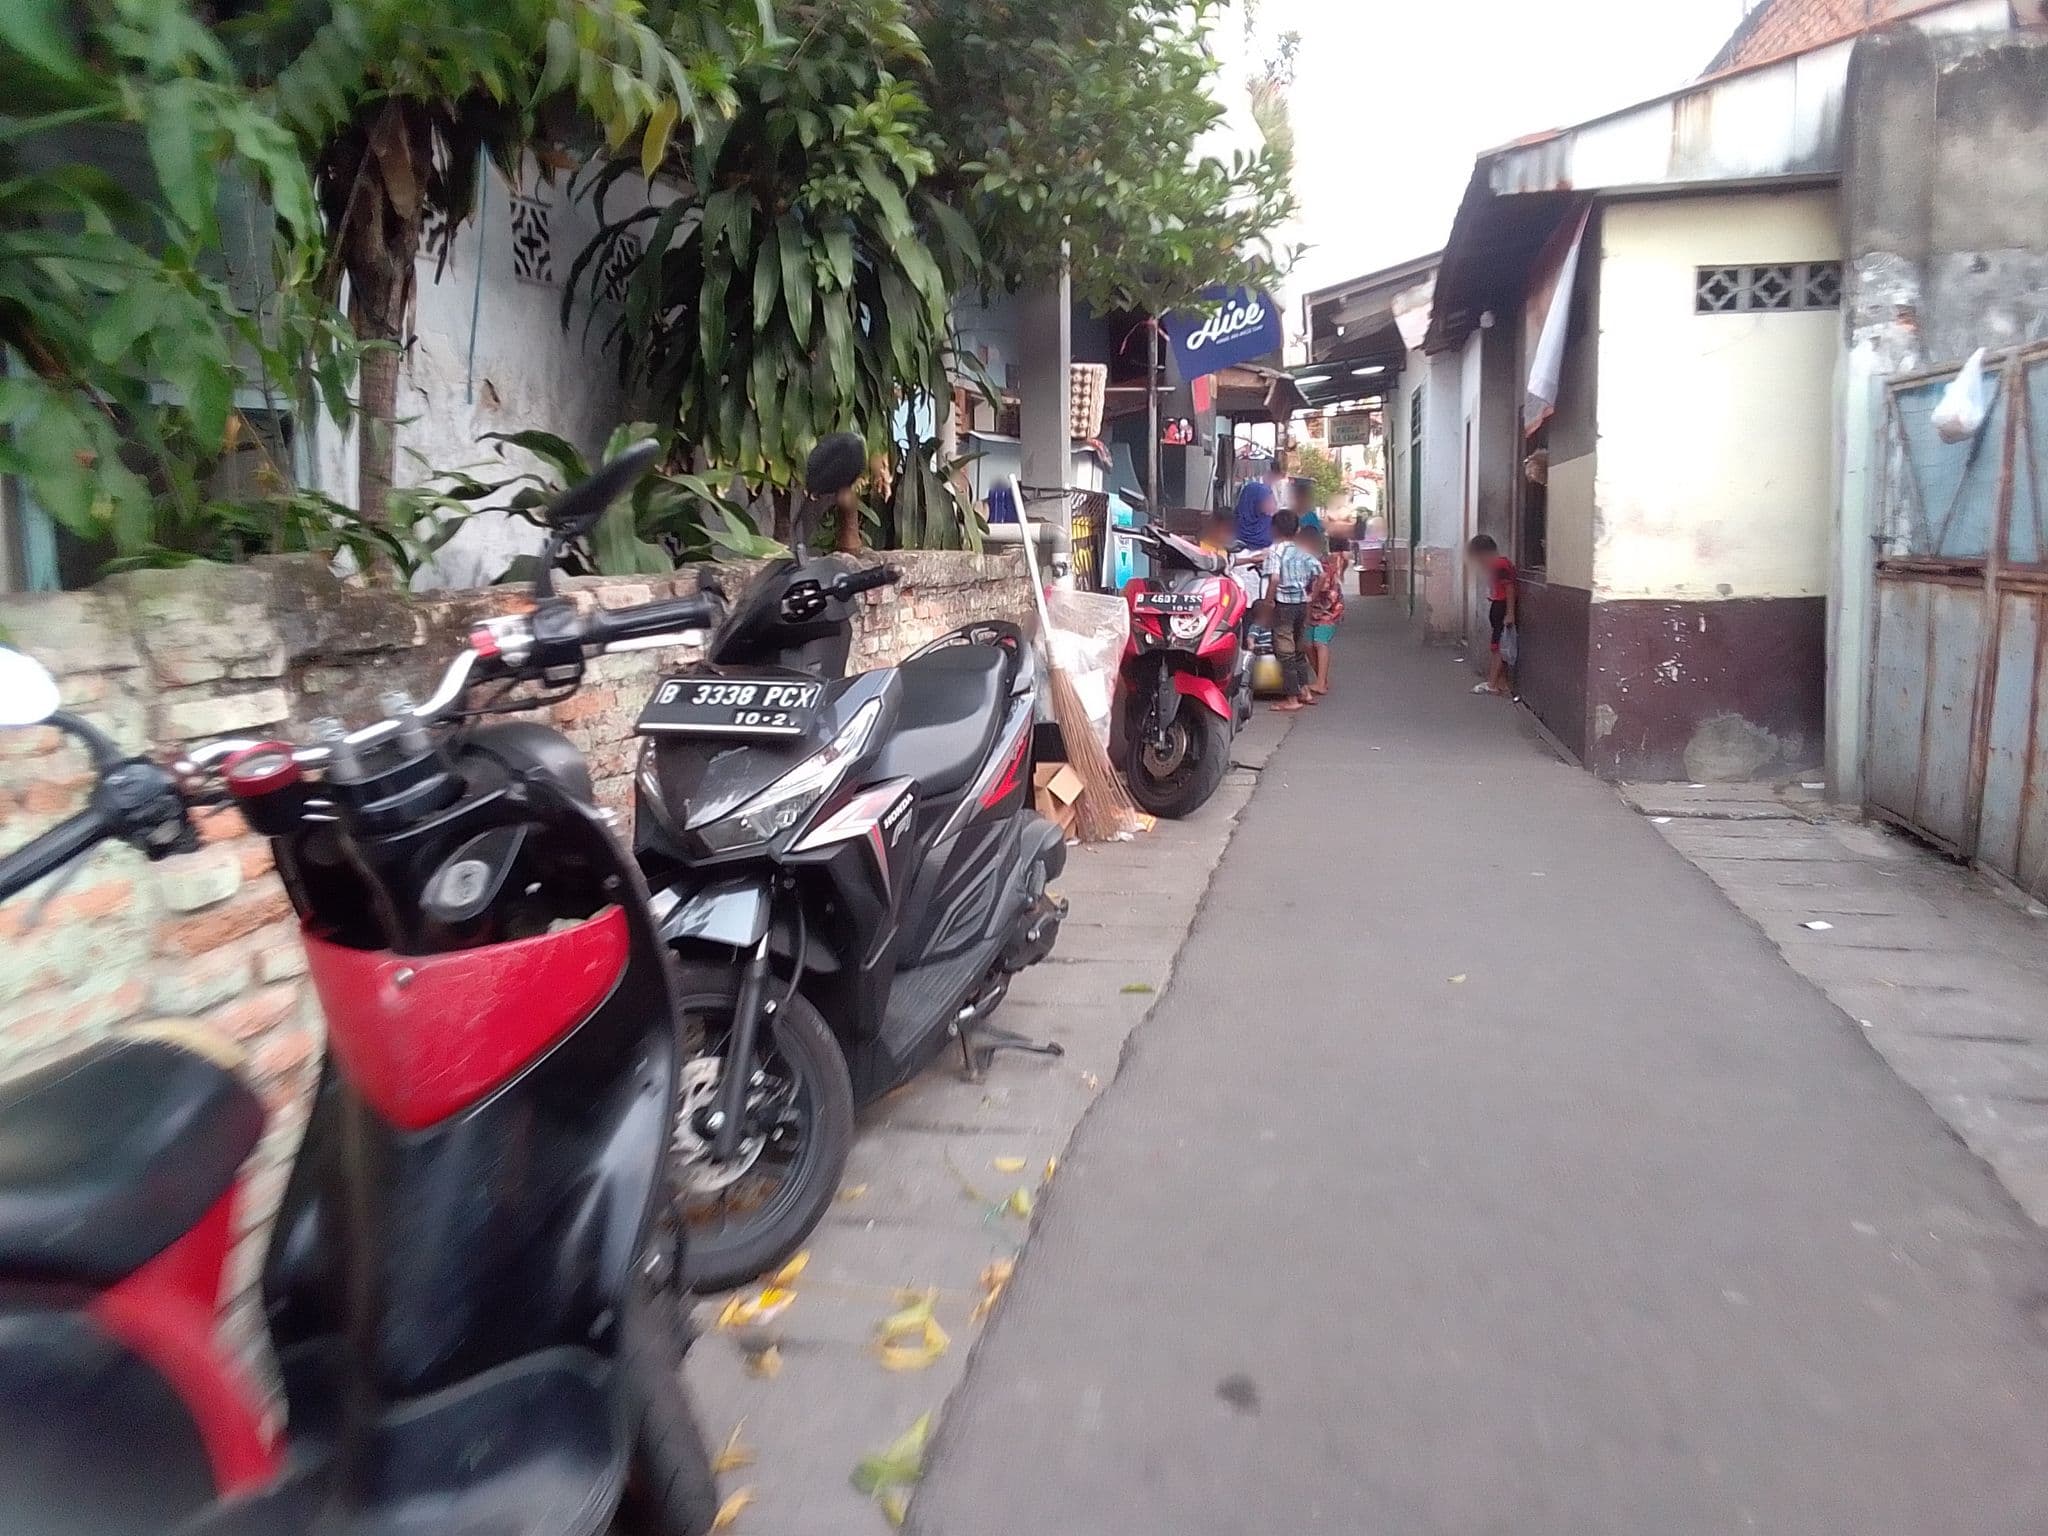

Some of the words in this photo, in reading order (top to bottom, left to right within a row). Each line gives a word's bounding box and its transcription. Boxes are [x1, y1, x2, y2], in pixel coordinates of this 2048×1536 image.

[659, 684, 681, 704] B
[762, 686, 816, 709] PCX
[883, 792, 914, 830] HONDA
